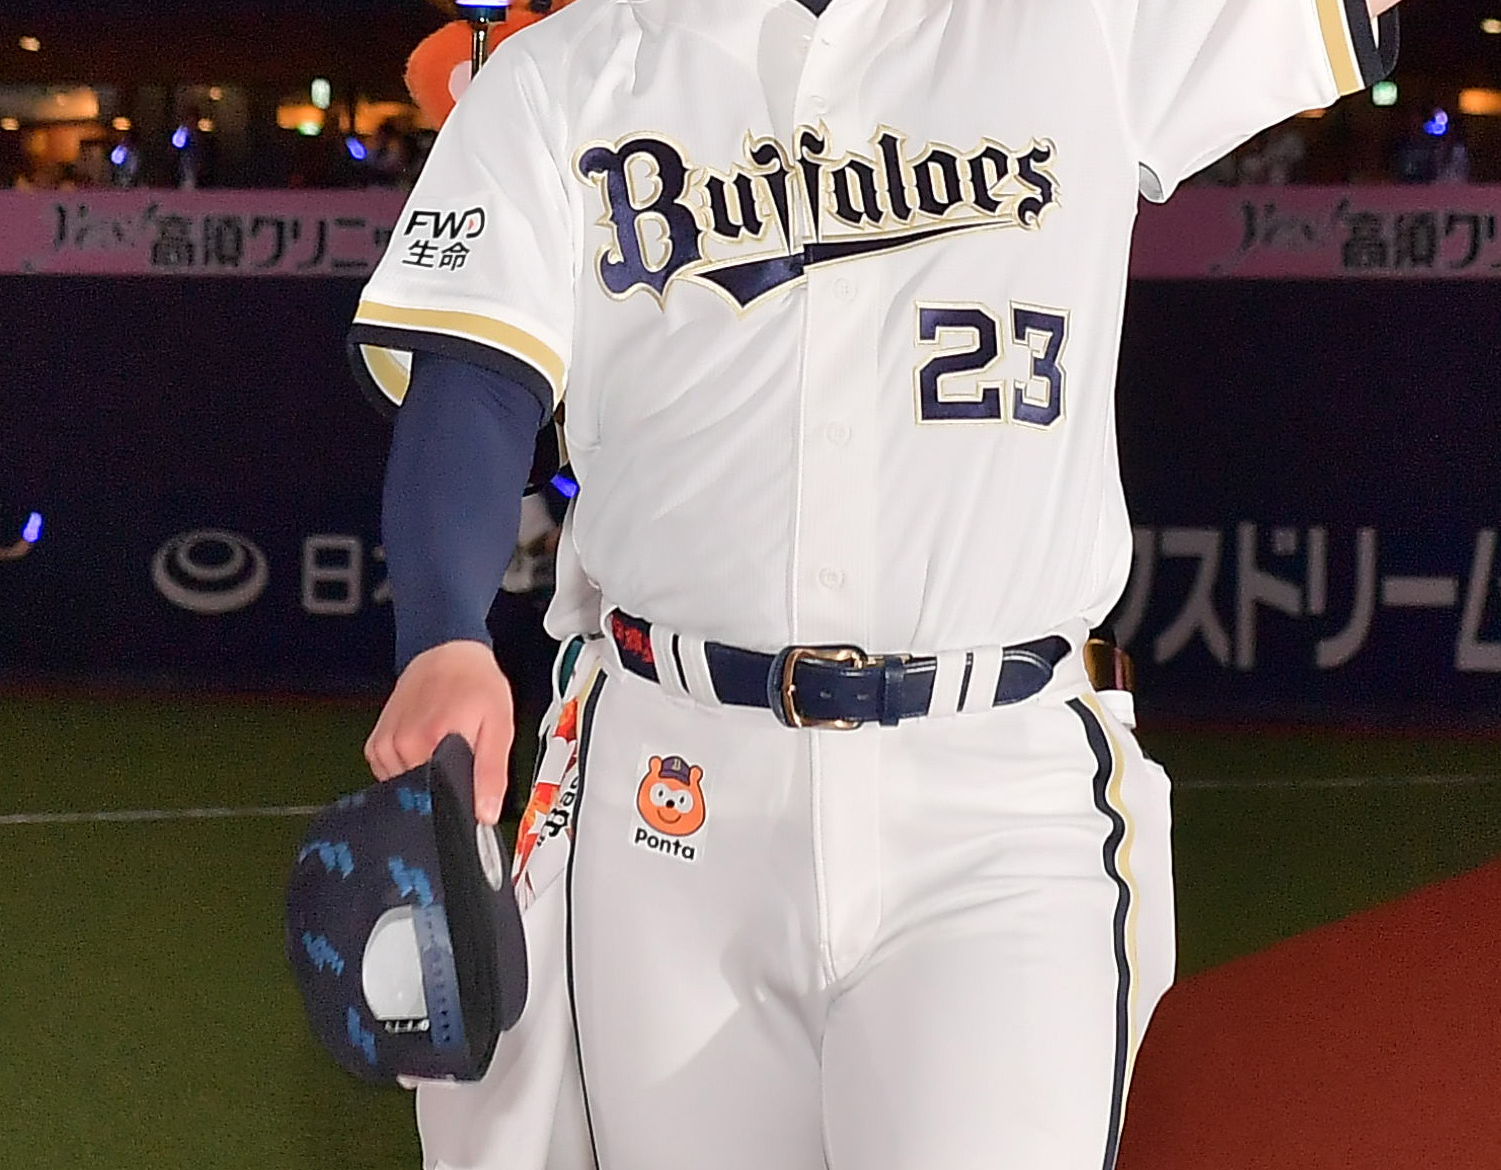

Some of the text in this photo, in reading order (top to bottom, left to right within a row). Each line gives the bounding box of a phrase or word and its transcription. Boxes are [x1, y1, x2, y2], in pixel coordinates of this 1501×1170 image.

[402, 239, 470, 272] 生命
[404, 207, 486, 240] FWD
[571, 119, 1062, 311] Buffaloes
[914, 298, 1072, 429] 23
[300, 533, 393, 616] 日
